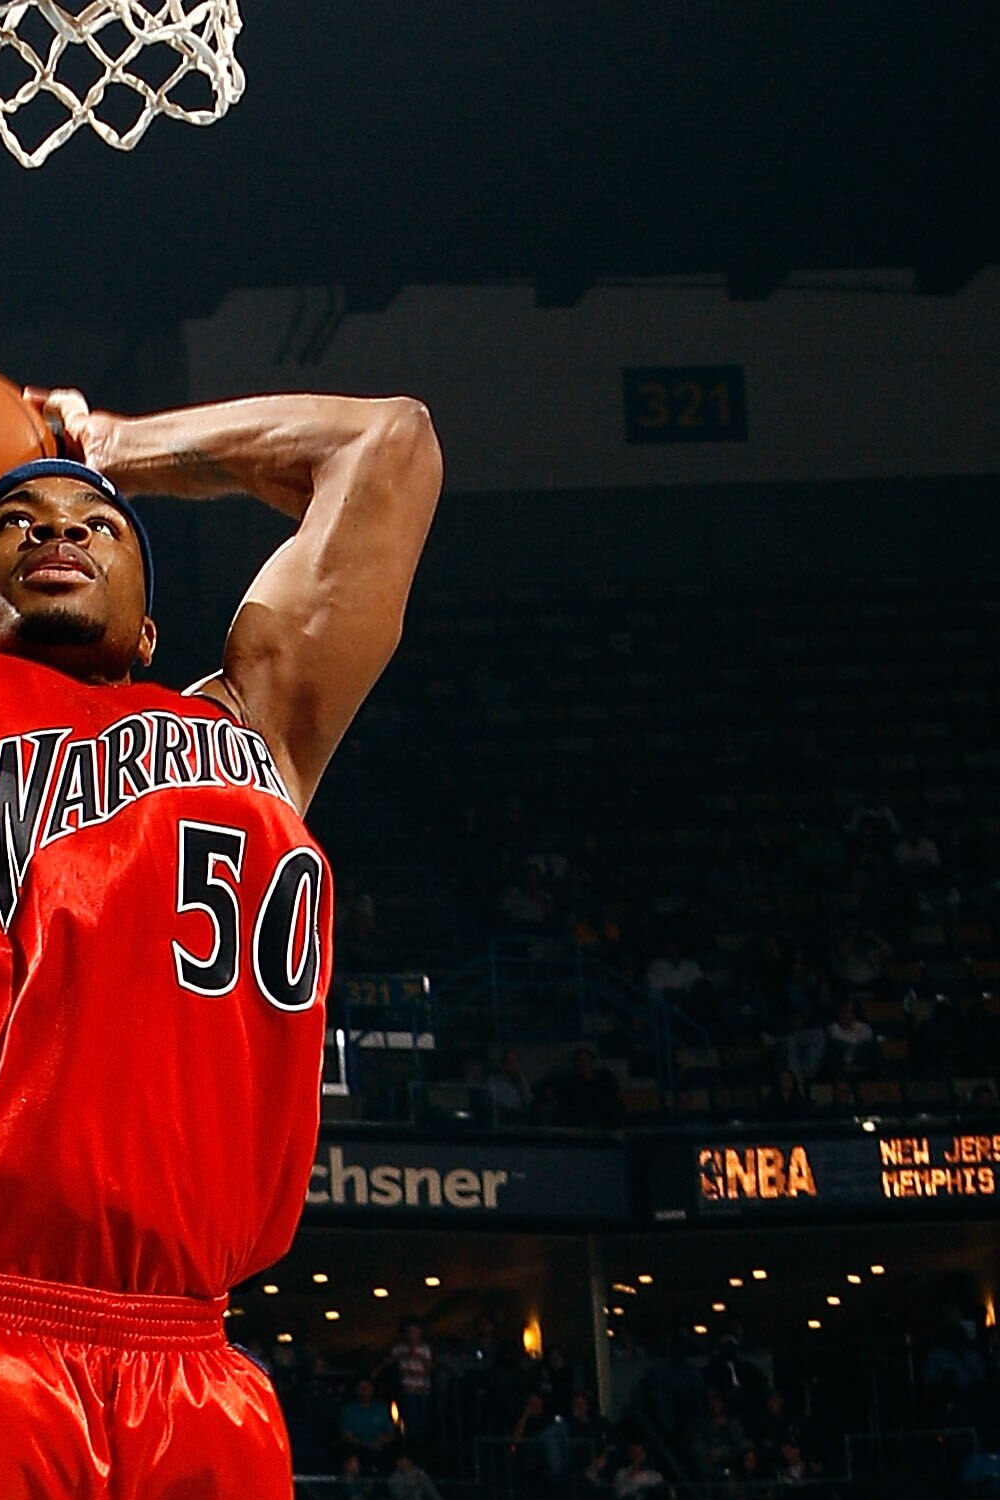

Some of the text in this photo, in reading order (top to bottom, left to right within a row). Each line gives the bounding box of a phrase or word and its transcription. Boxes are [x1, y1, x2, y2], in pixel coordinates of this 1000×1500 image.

[638, 380, 729, 428] 321
[171, 820, 324, 1013] 50
[723, 1145, 818, 1200] NBA
[879, 1137, 930, 1166] NEW
[882, 1166, 995, 1198] MEMPHIS
